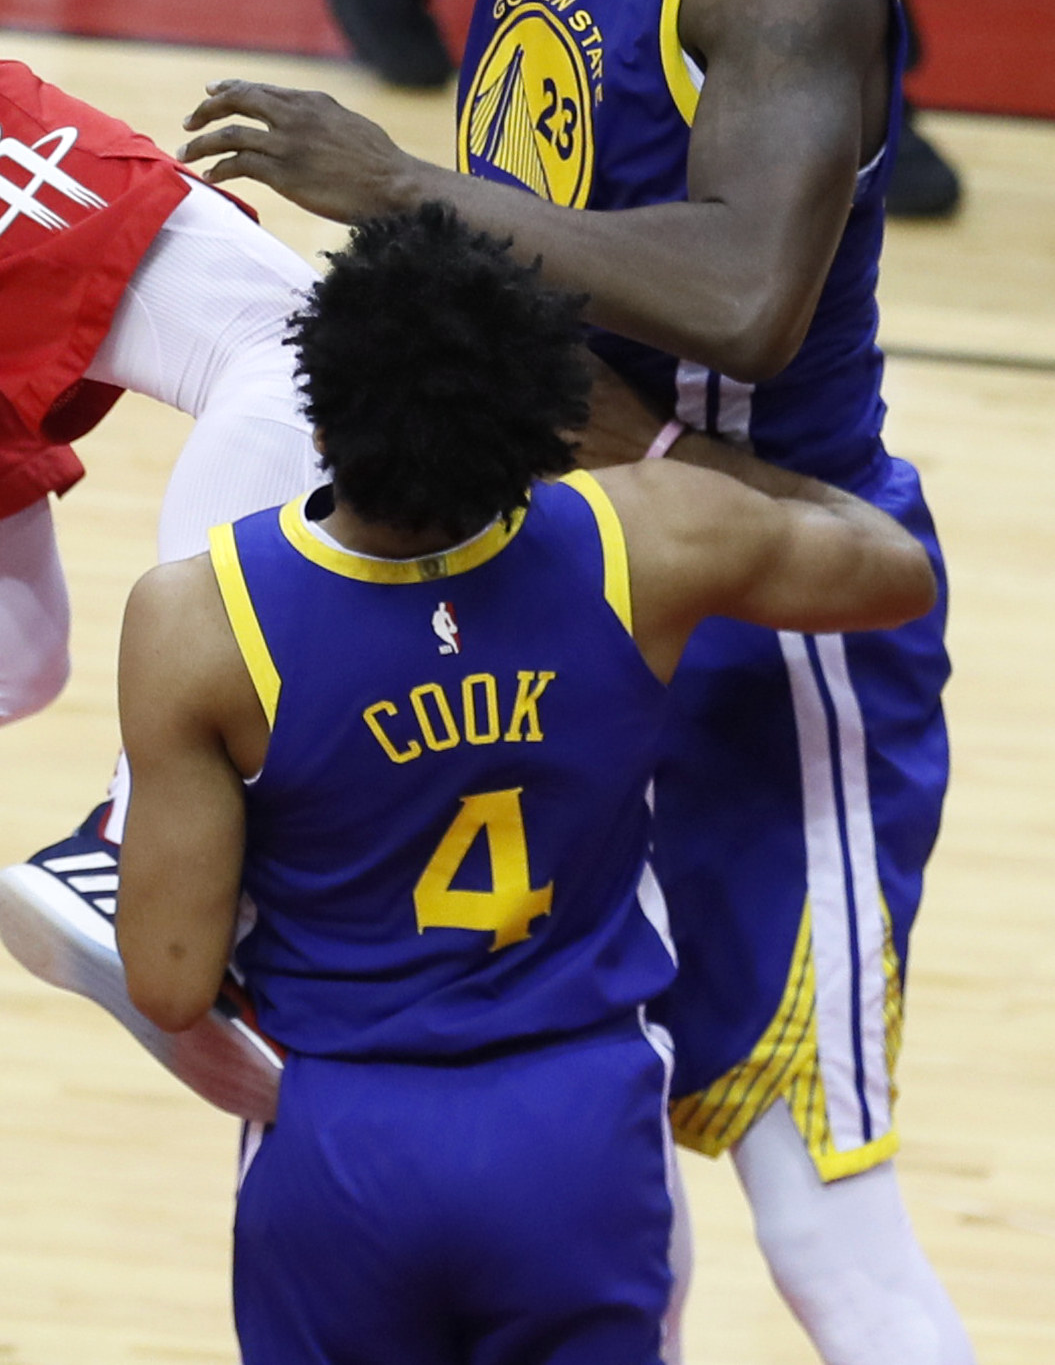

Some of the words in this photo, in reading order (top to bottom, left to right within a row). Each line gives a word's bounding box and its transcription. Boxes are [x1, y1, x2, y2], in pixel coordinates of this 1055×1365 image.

[568, 9, 604, 107] STATE
[535, 77, 578, 161] 23
[362, 670, 556, 764] COOK
[412, 786, 555, 954] 4
